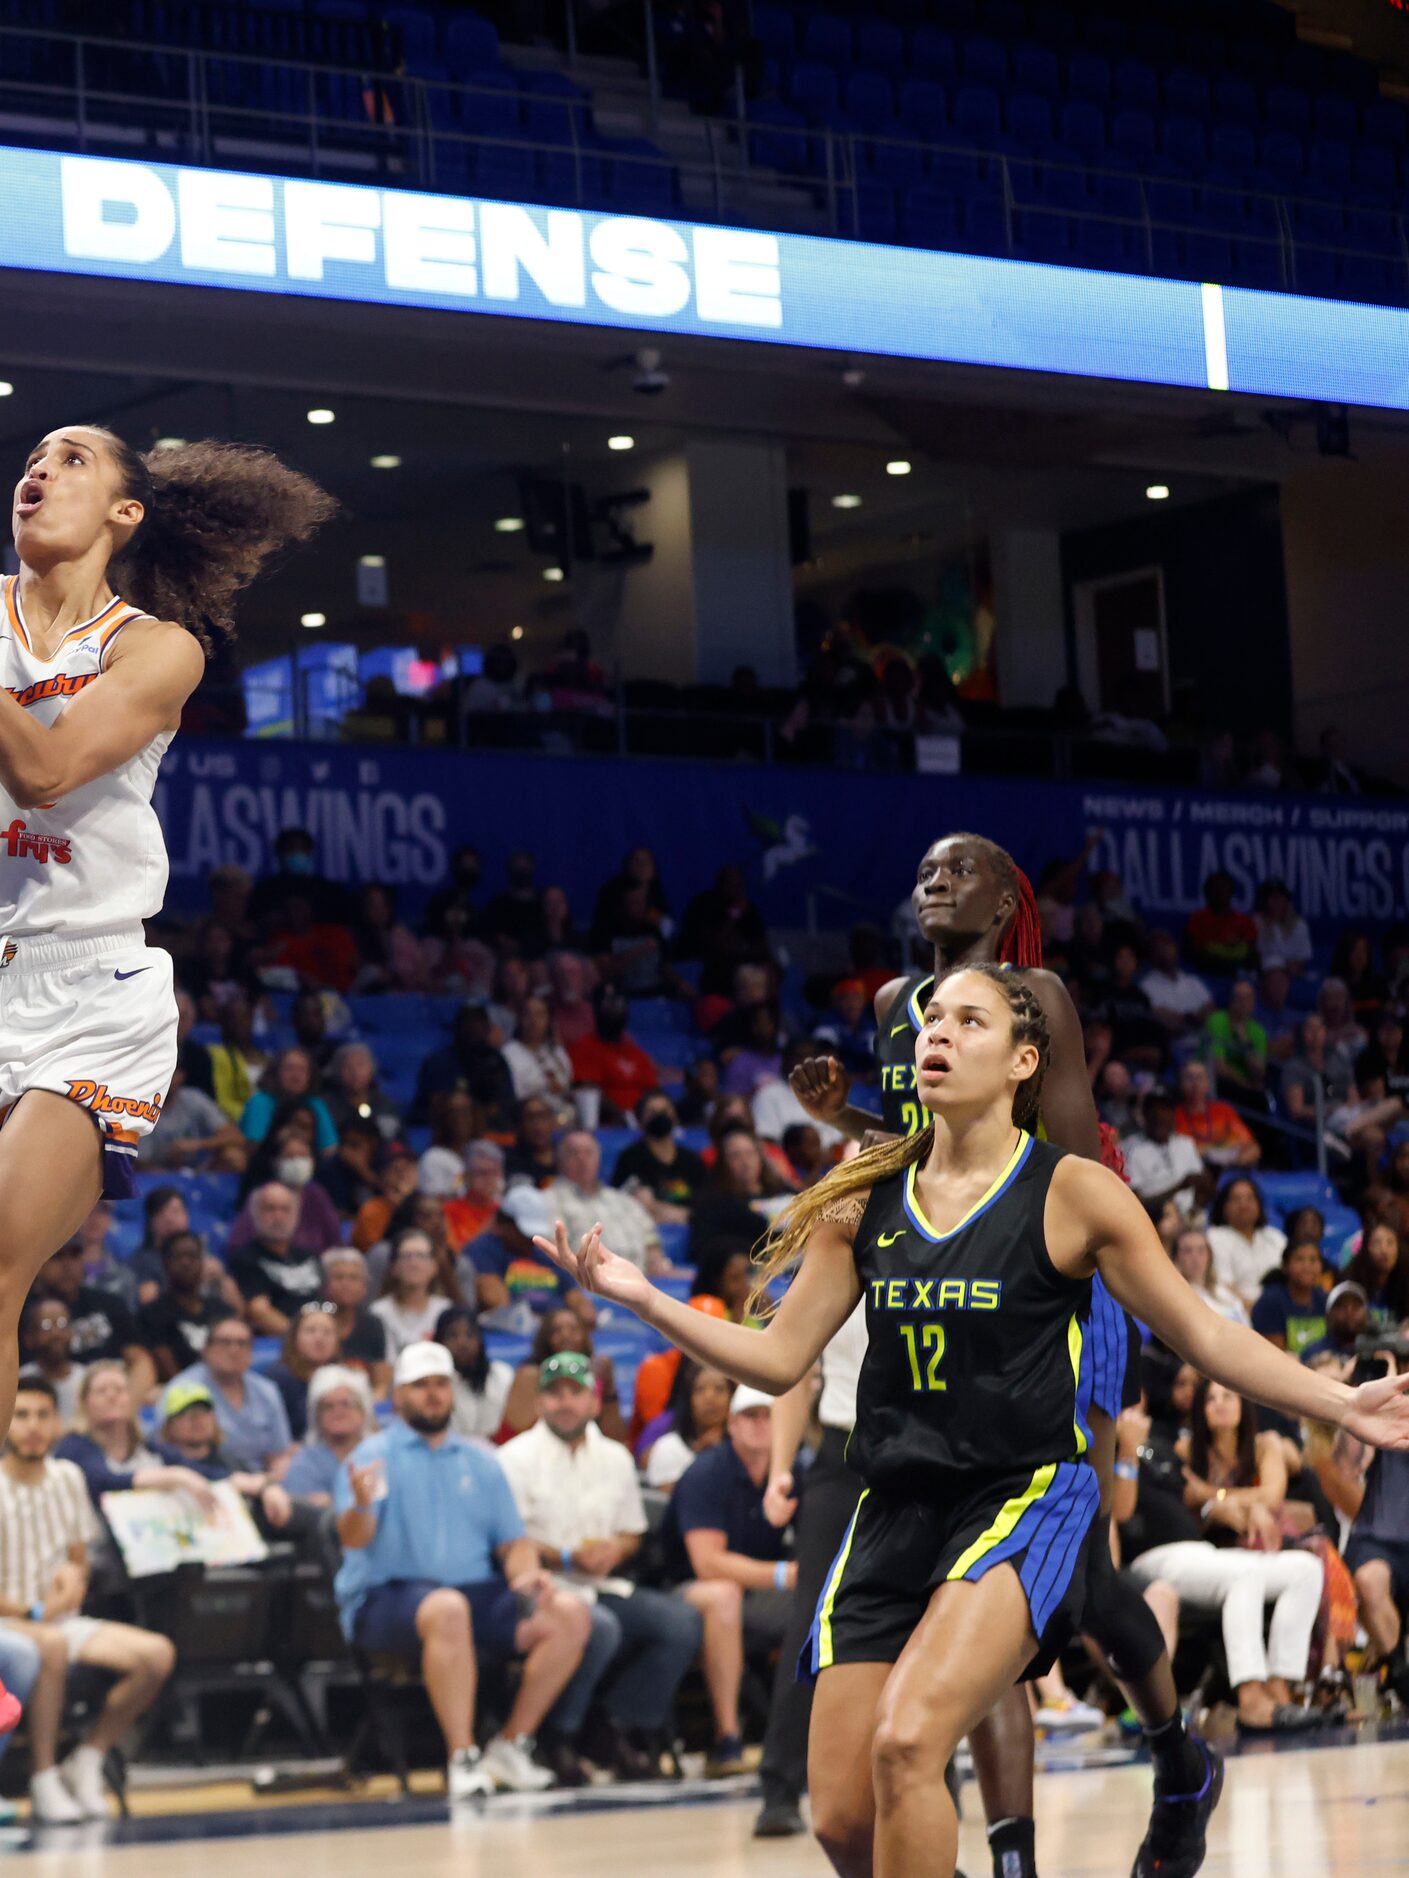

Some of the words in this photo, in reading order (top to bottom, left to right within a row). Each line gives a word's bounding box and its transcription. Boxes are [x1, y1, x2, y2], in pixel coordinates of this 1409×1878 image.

[60, 155, 784, 328] DEFENSE
[1083, 797, 1164, 820] NEWS
[19, 832, 36, 842] FOOD
[37, 835, 68, 846] STORES
[870, 1278, 1002, 1311] TEXAS
[898, 1323, 949, 1393] 12
